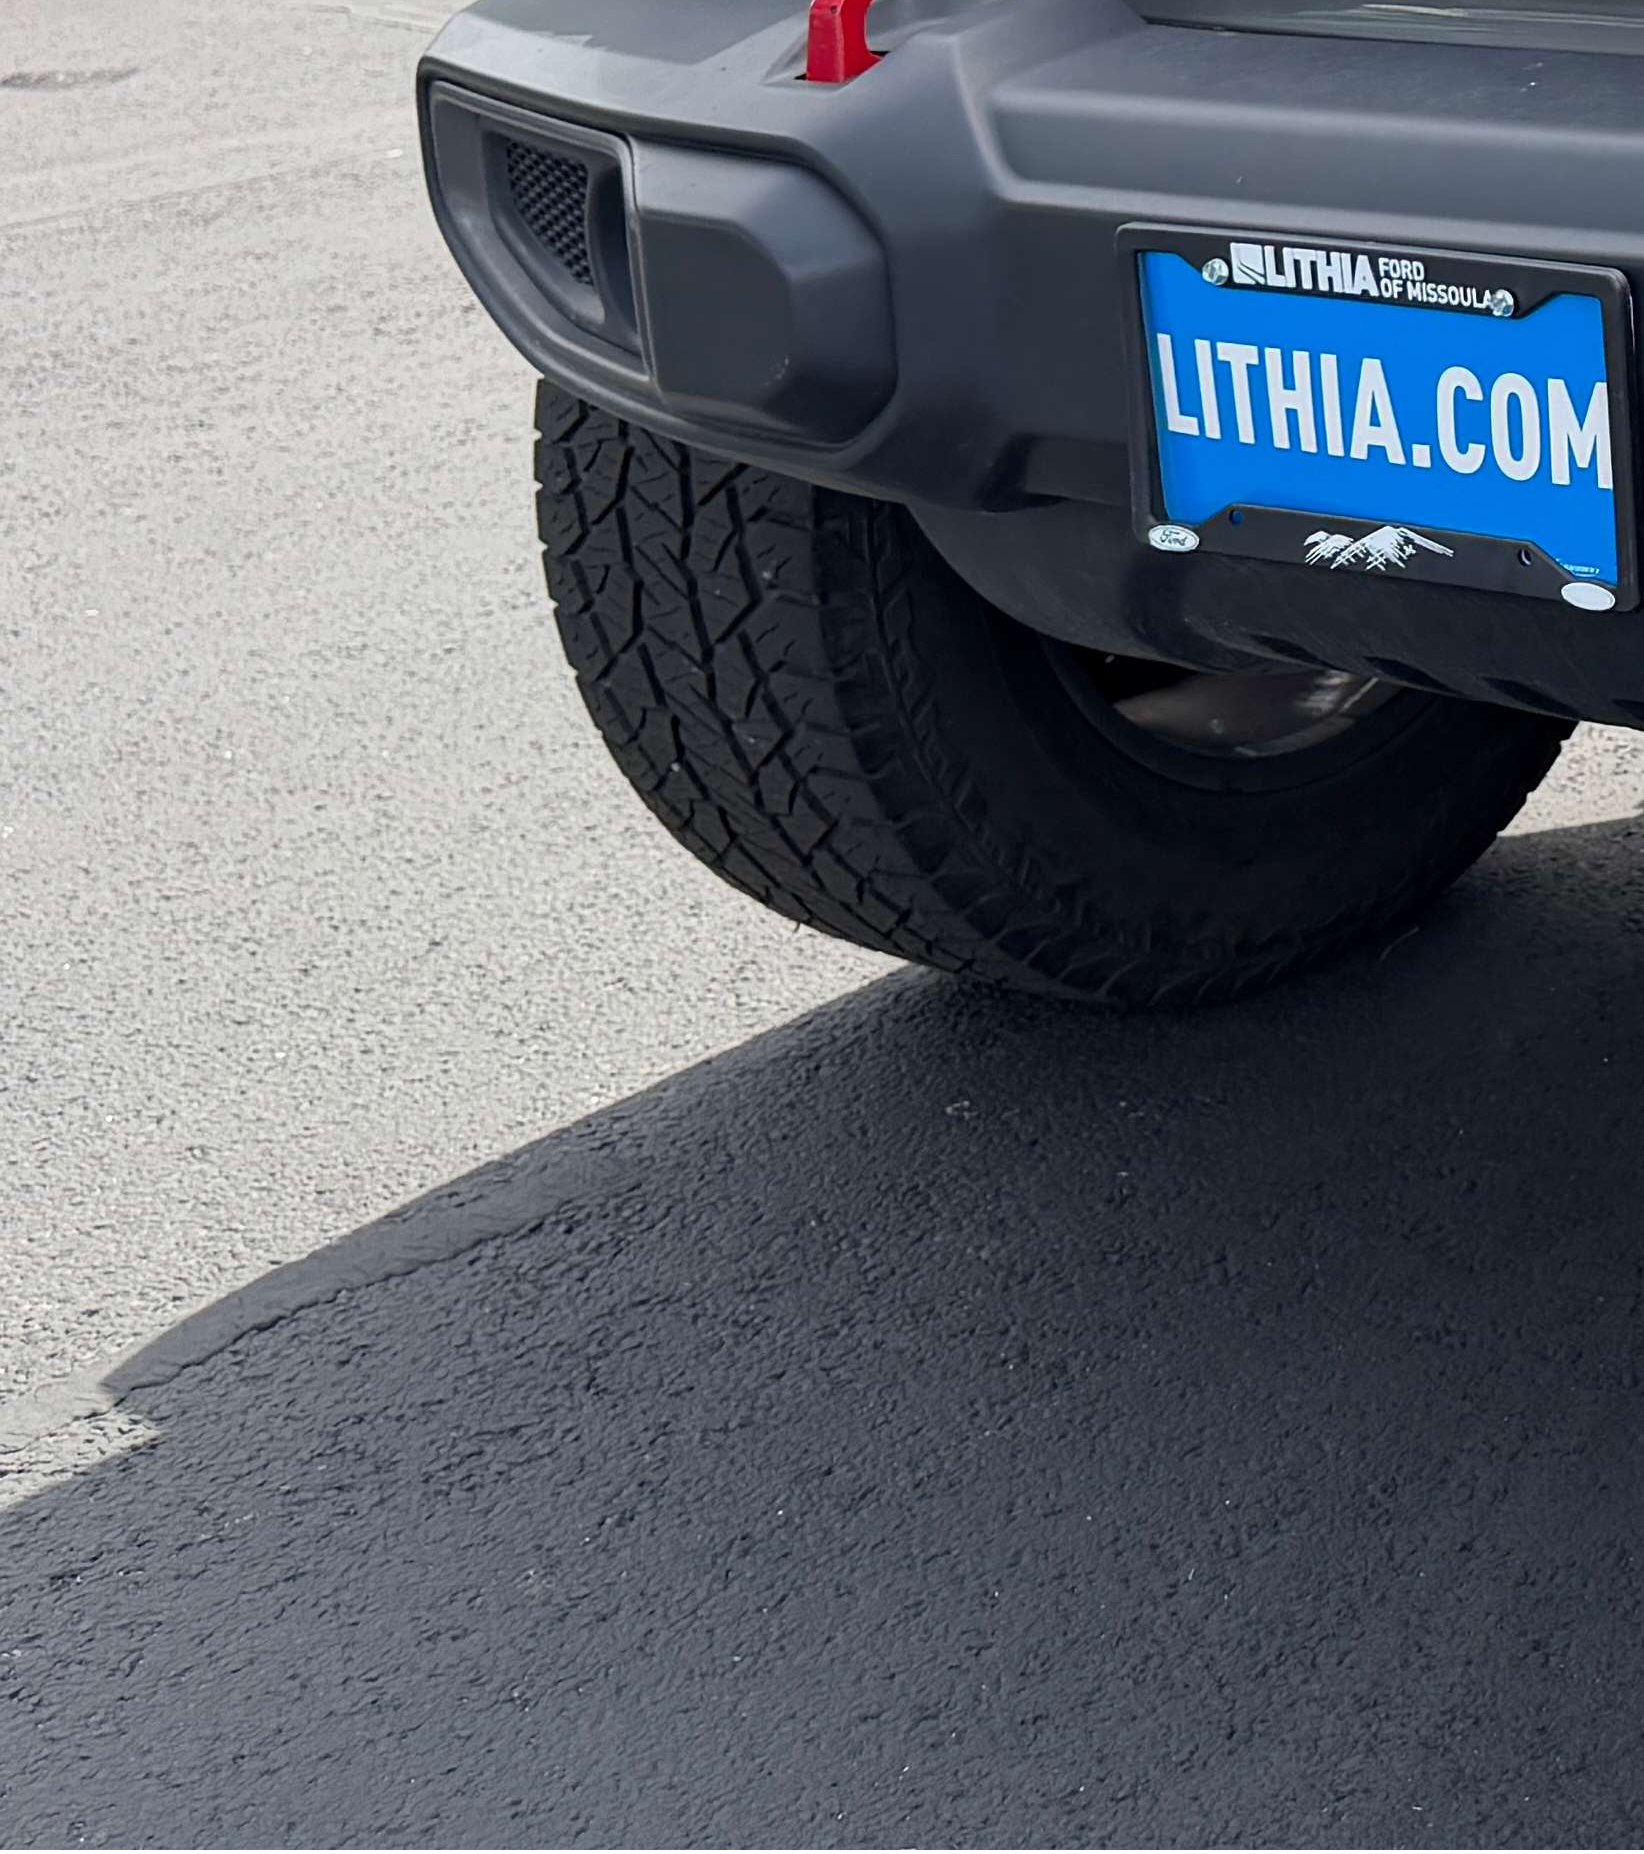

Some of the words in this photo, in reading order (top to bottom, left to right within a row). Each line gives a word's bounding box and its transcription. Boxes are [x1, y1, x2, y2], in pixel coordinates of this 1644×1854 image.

[1263, 244, 1380, 297] LITHIA
[1378, 257, 1425, 282] FORD
[1380, 279, 1404, 300] OF
[1407, 281, 1493, 310] MISSOULA
[1156, 332, 1614, 490] LITHIA.COM
